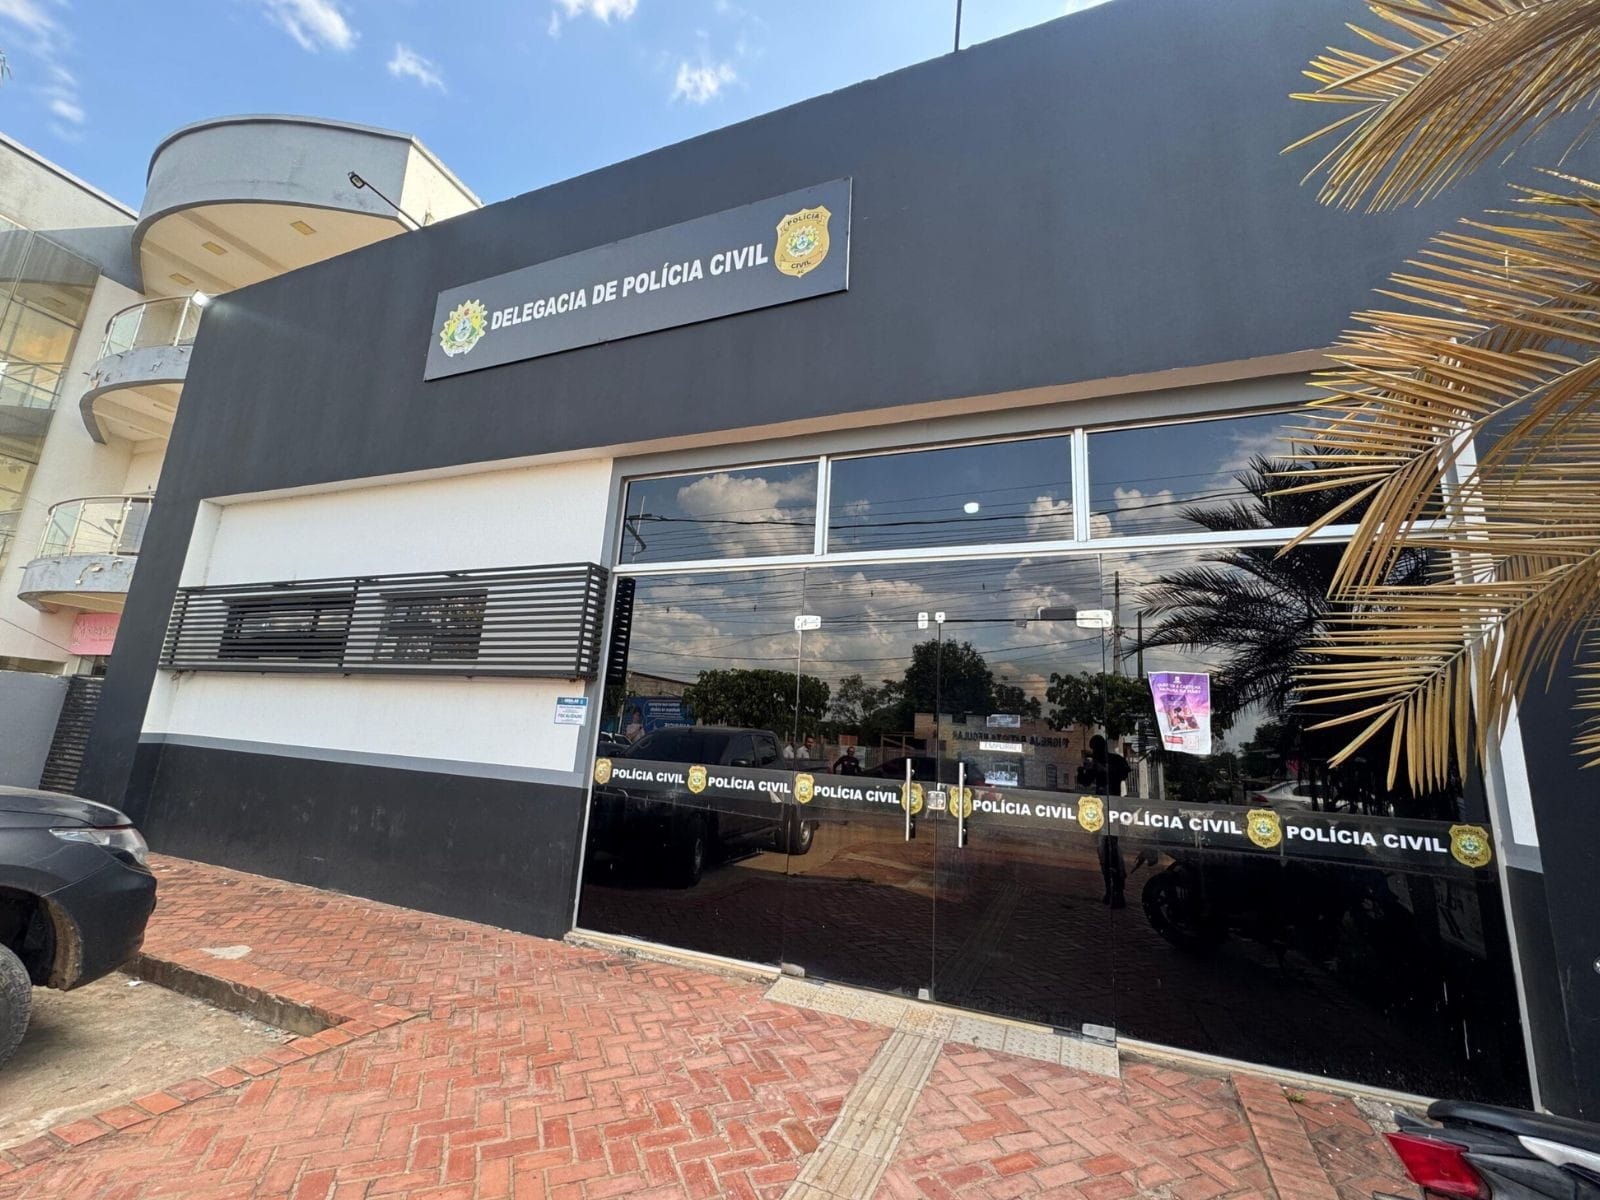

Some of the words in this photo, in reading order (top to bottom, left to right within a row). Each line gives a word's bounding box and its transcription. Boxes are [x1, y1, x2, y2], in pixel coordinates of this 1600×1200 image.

[787, 213, 820, 227] POLÍCIA
[791, 260, 811, 269] CIVIL
[491, 289, 587, 331] DELEGACIA
[592, 279, 618, 305] DE
[622, 260, 704, 298] POLÍCIA
[710, 243, 769, 276] CIVIL
[611, 767, 653, 782] POLÍCIA
[656, 772, 685, 784] CIVIL
[708, 775, 755, 791] POLÍCIA
[758, 780, 792, 794] CIVIL
[814, 783, 862, 801] POLÍCIA
[865, 790, 901, 804] CIVIL
[973, 798, 1031, 817] POLÍCIA
[1035, 805, 1077, 821] CIVIL
[1109, 810, 1184, 830] POLÍCIA
[1189, 817, 1243, 835] CIVIL
[1286, 825, 1377, 847] POLÍCIA
[1383, 833, 1448, 853] CIVIL
